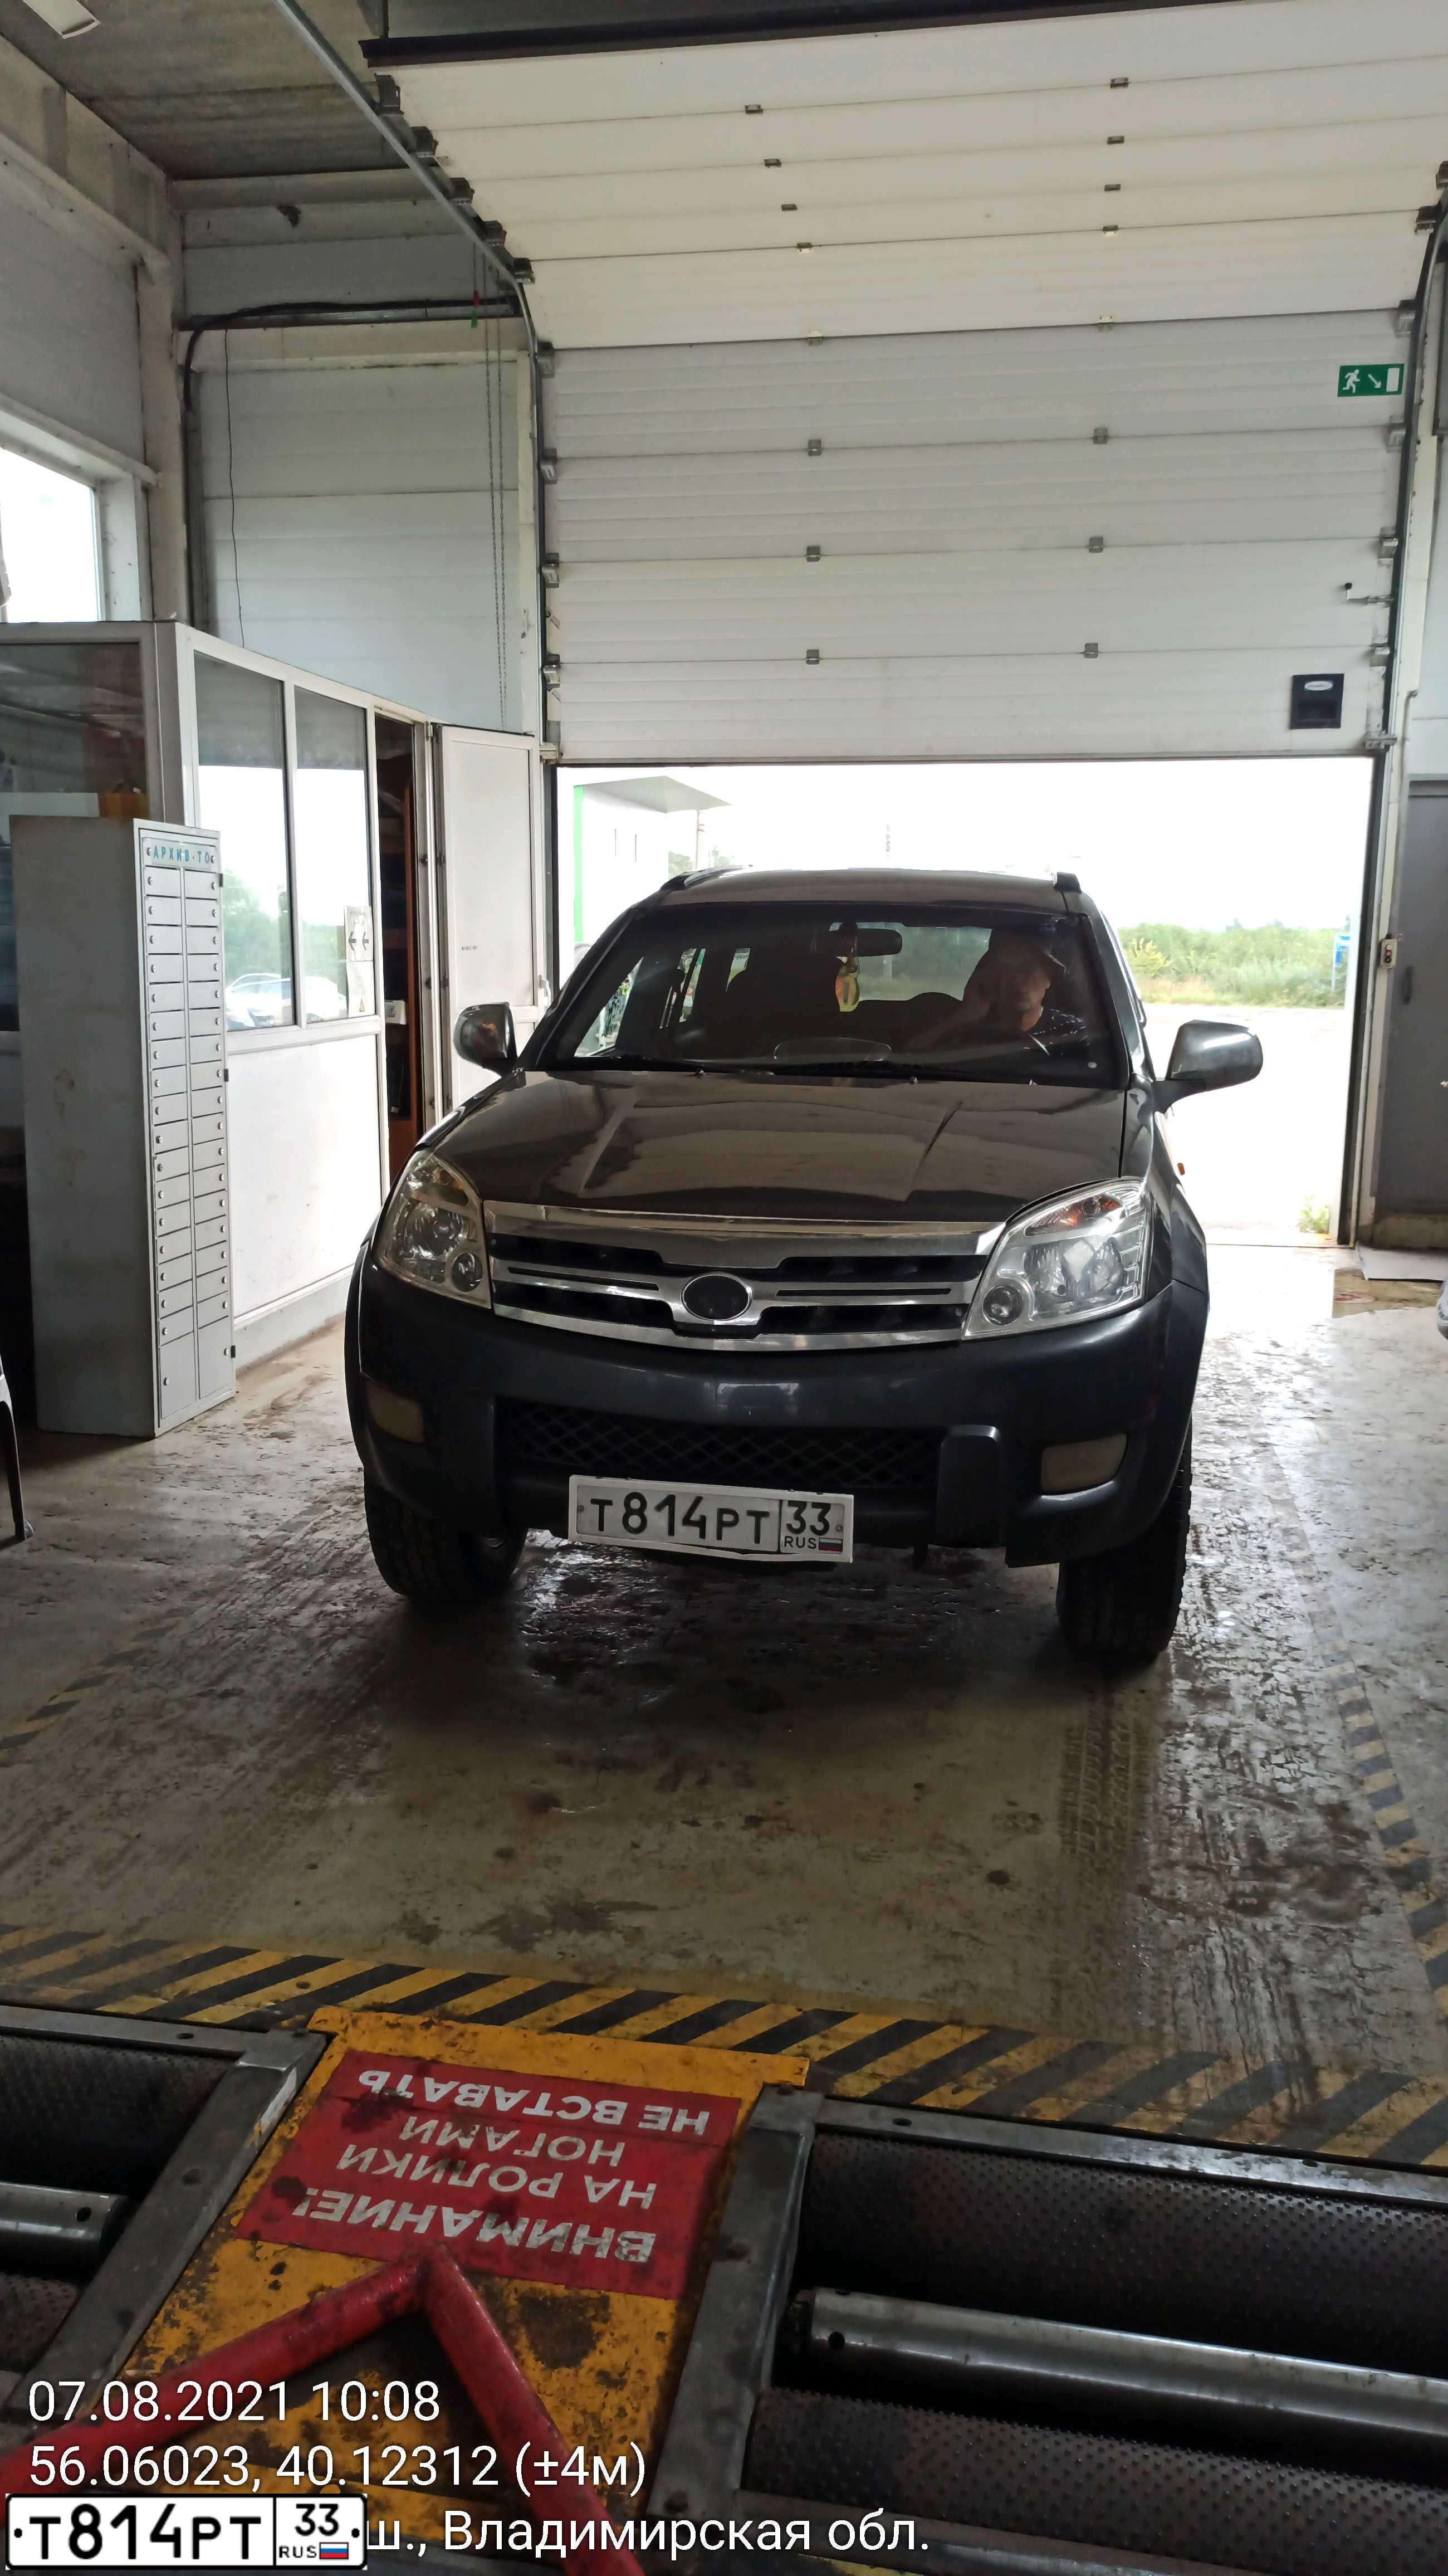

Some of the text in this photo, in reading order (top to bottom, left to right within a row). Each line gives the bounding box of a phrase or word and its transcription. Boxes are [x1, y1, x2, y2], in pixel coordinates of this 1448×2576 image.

[784, 1535, 818, 1549] RUS
[359, 2070, 710, 2136] НЕ ВСТАВАТЬ
[399, 2116, 625, 2167] НОГАМИ
[336, 2144, 657, 2210] НА РОЛИКИ
[293, 2187, 657, 2263] ВНИМАНИЕ!
